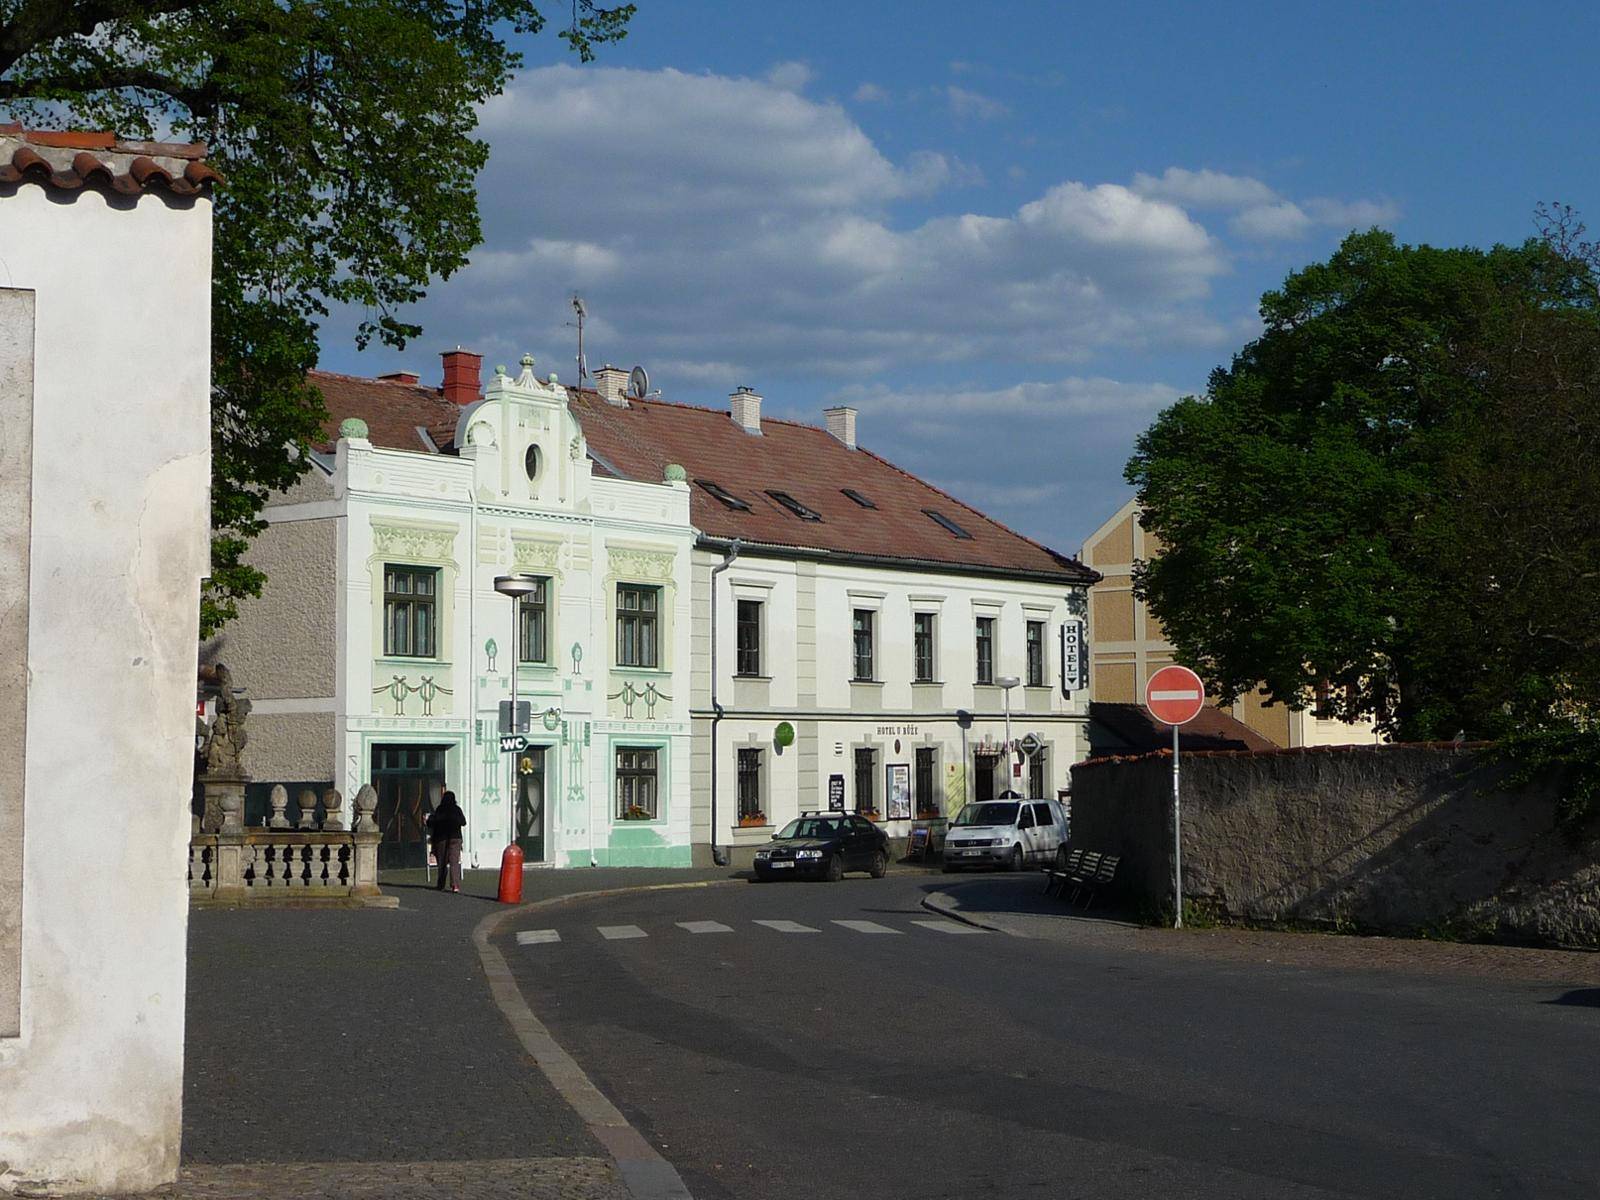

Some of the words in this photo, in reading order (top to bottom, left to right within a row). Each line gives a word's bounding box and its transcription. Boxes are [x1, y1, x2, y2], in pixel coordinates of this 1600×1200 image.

[1066, 625, 1077, 672] HOTEL
[877, 727, 896, 735] HOTEL
[502, 738, 524, 750] WC
